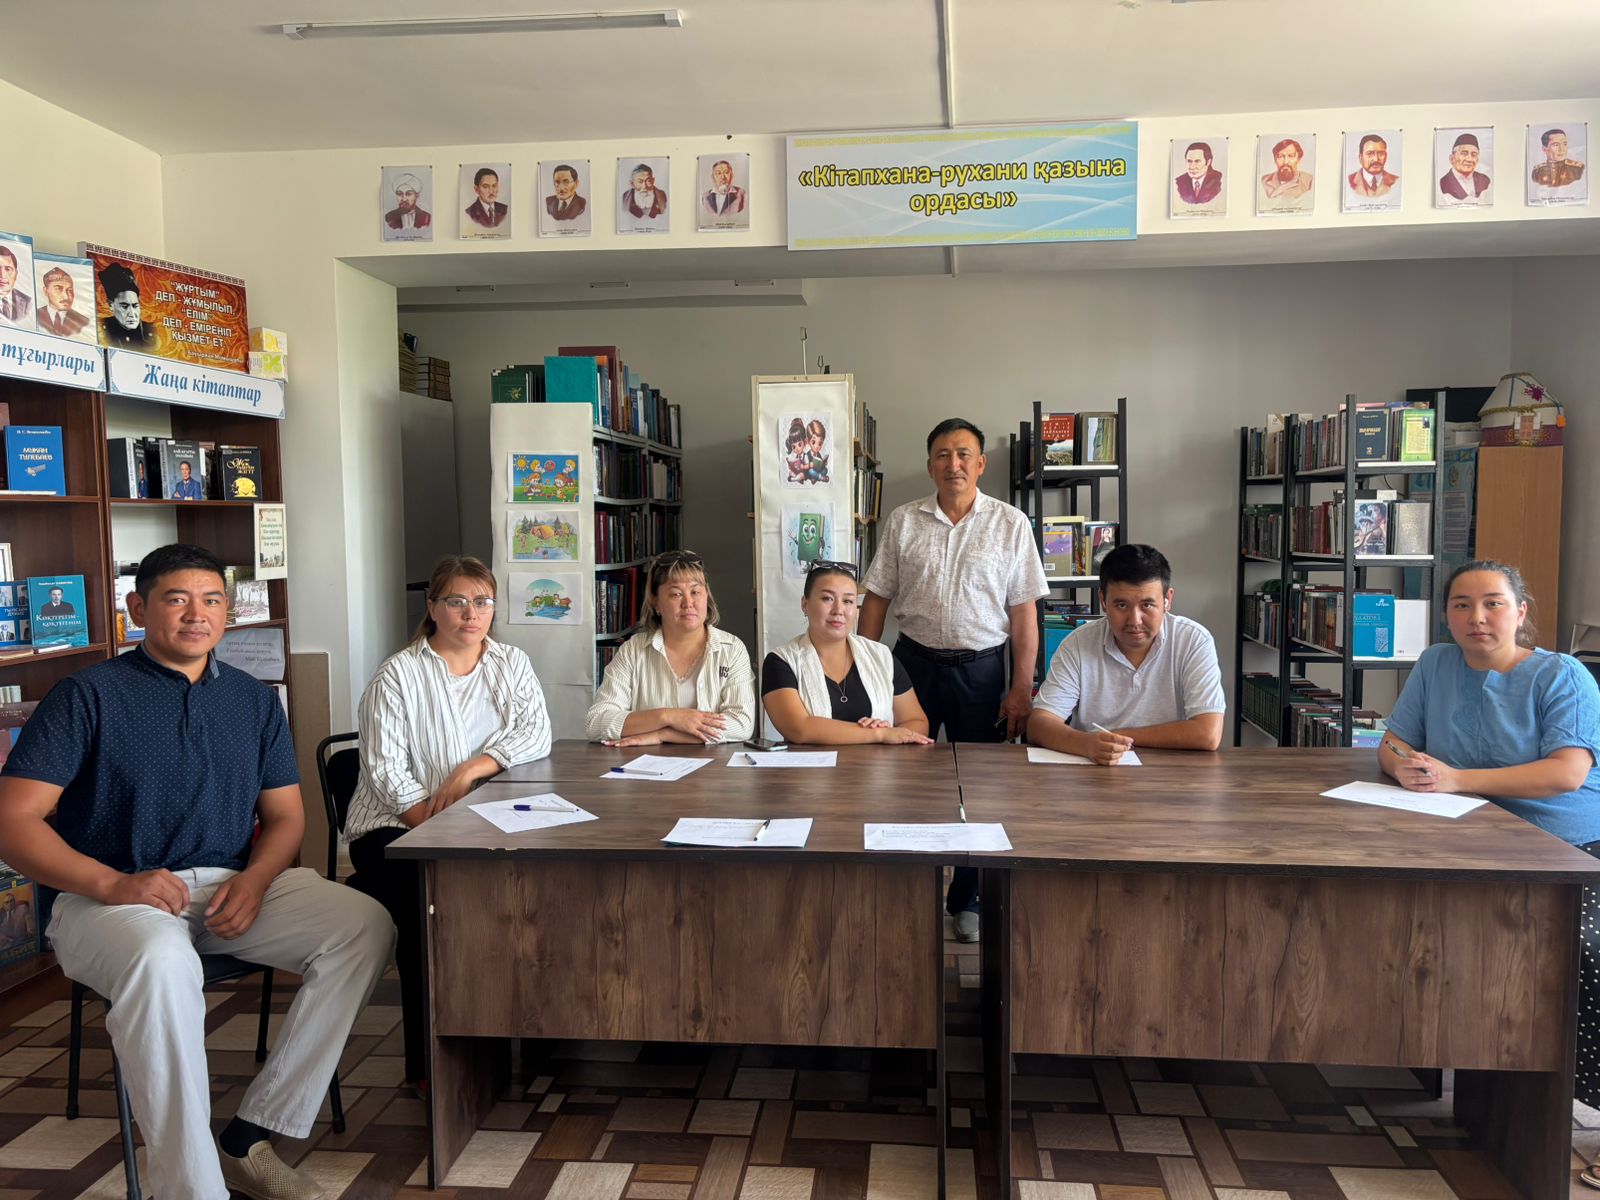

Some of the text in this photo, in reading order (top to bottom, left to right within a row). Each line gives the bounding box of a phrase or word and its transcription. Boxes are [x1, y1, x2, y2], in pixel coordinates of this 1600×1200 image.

[798, 157, 1127, 188] «Кітапхана-рухани қазына
[909, 190, 1018, 216] ордасы»
[155, 290, 176, 304] ДЕП
[162, 317, 182, 329] ДЕП
[1, 343, 96, 376] тұғырлары
[142, 363, 262, 407] Жаңа кітаптар
